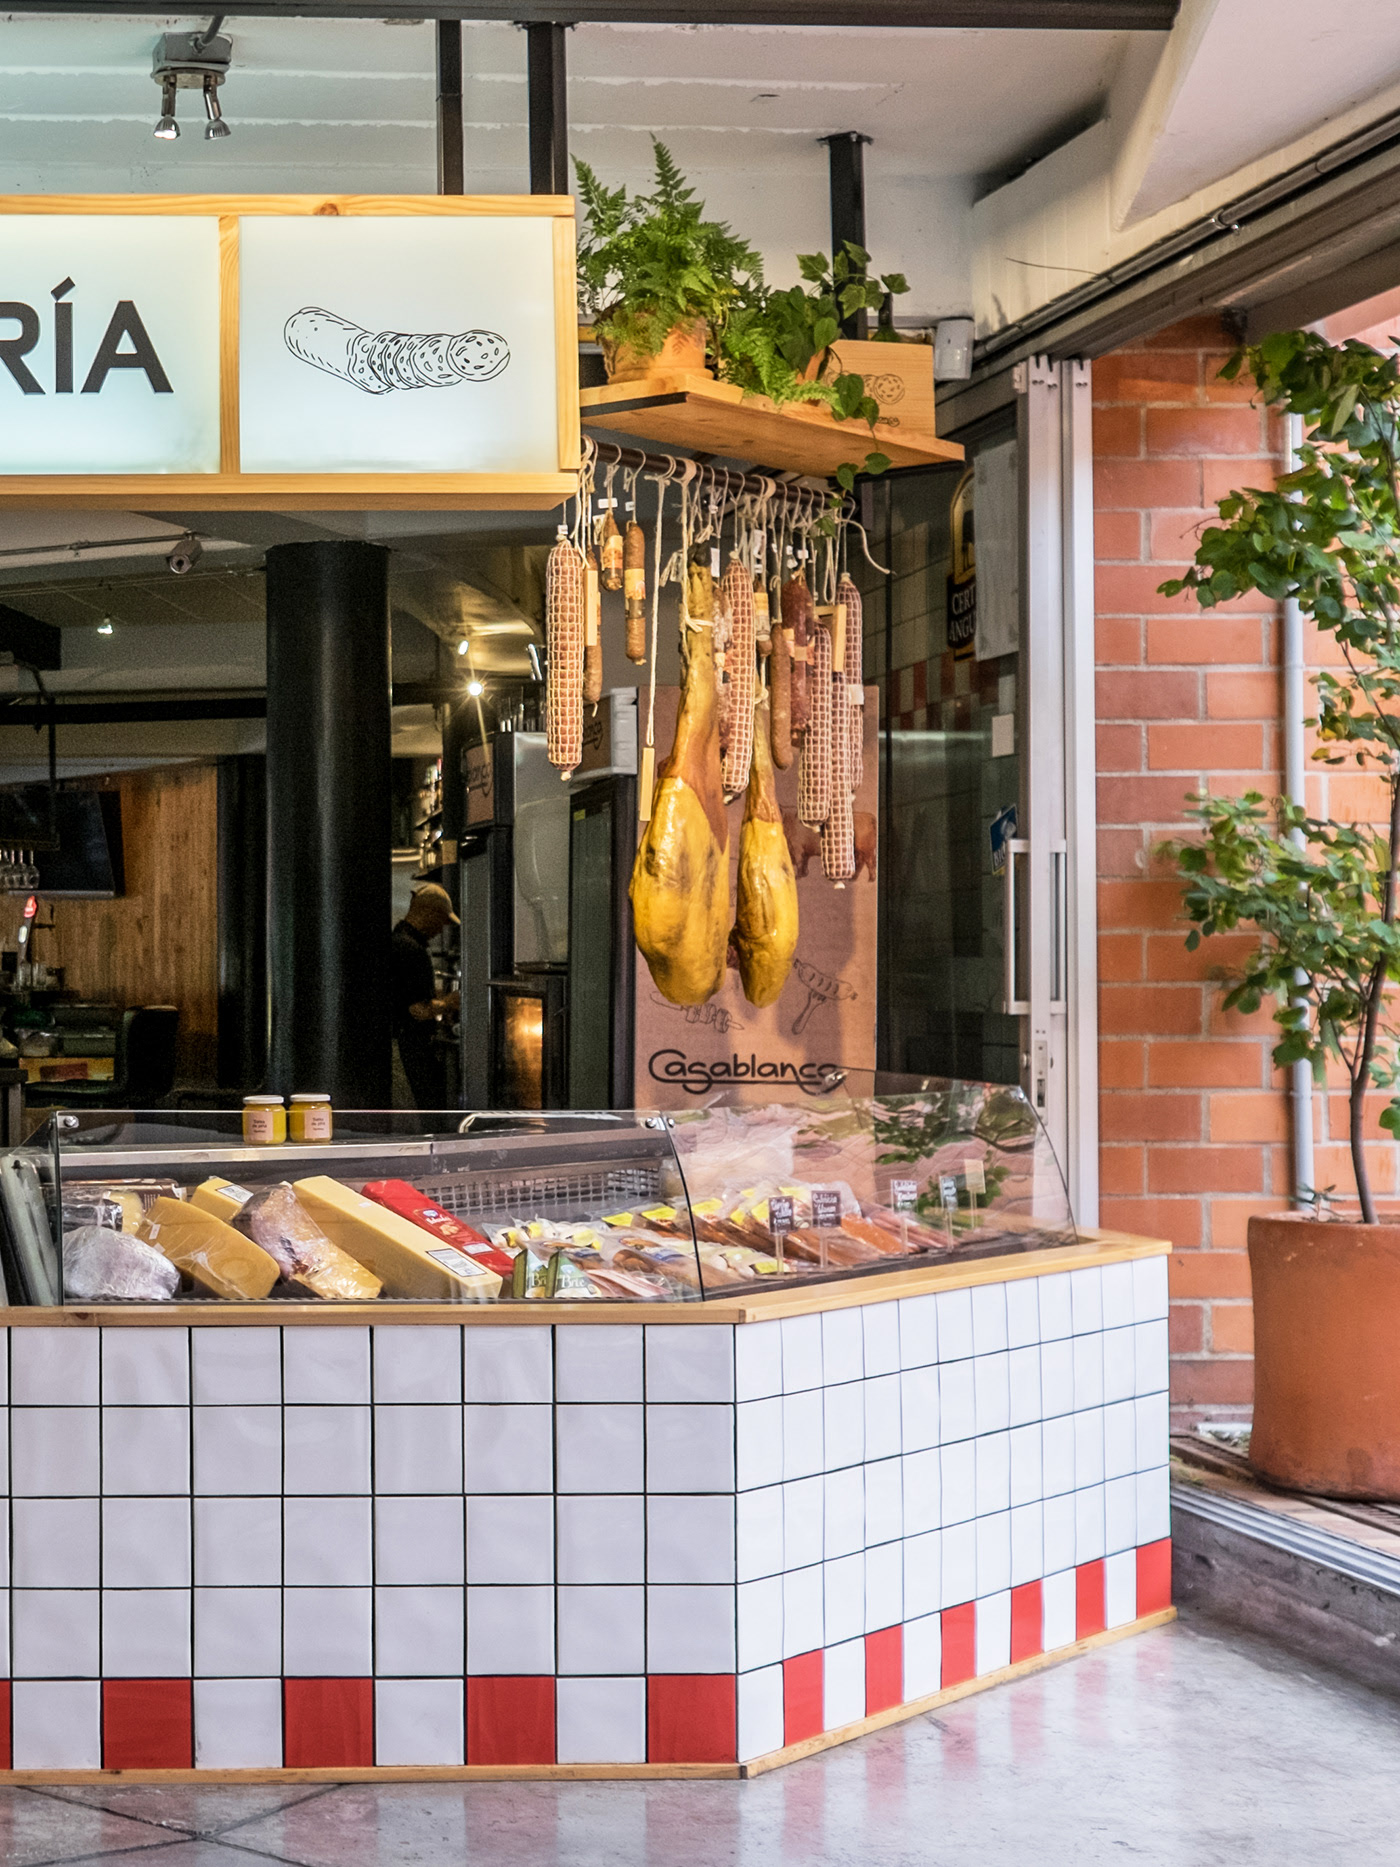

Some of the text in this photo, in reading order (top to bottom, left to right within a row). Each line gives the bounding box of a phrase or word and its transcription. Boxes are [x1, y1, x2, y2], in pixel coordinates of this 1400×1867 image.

[952, 584, 976, 615] CERT
[949, 611, 976, 641] ANGU
[648, 1049, 847, 1096] Casablanca
[531, 1272, 547, 1287] Bri
[561, 1274, 585, 1288] Brie
